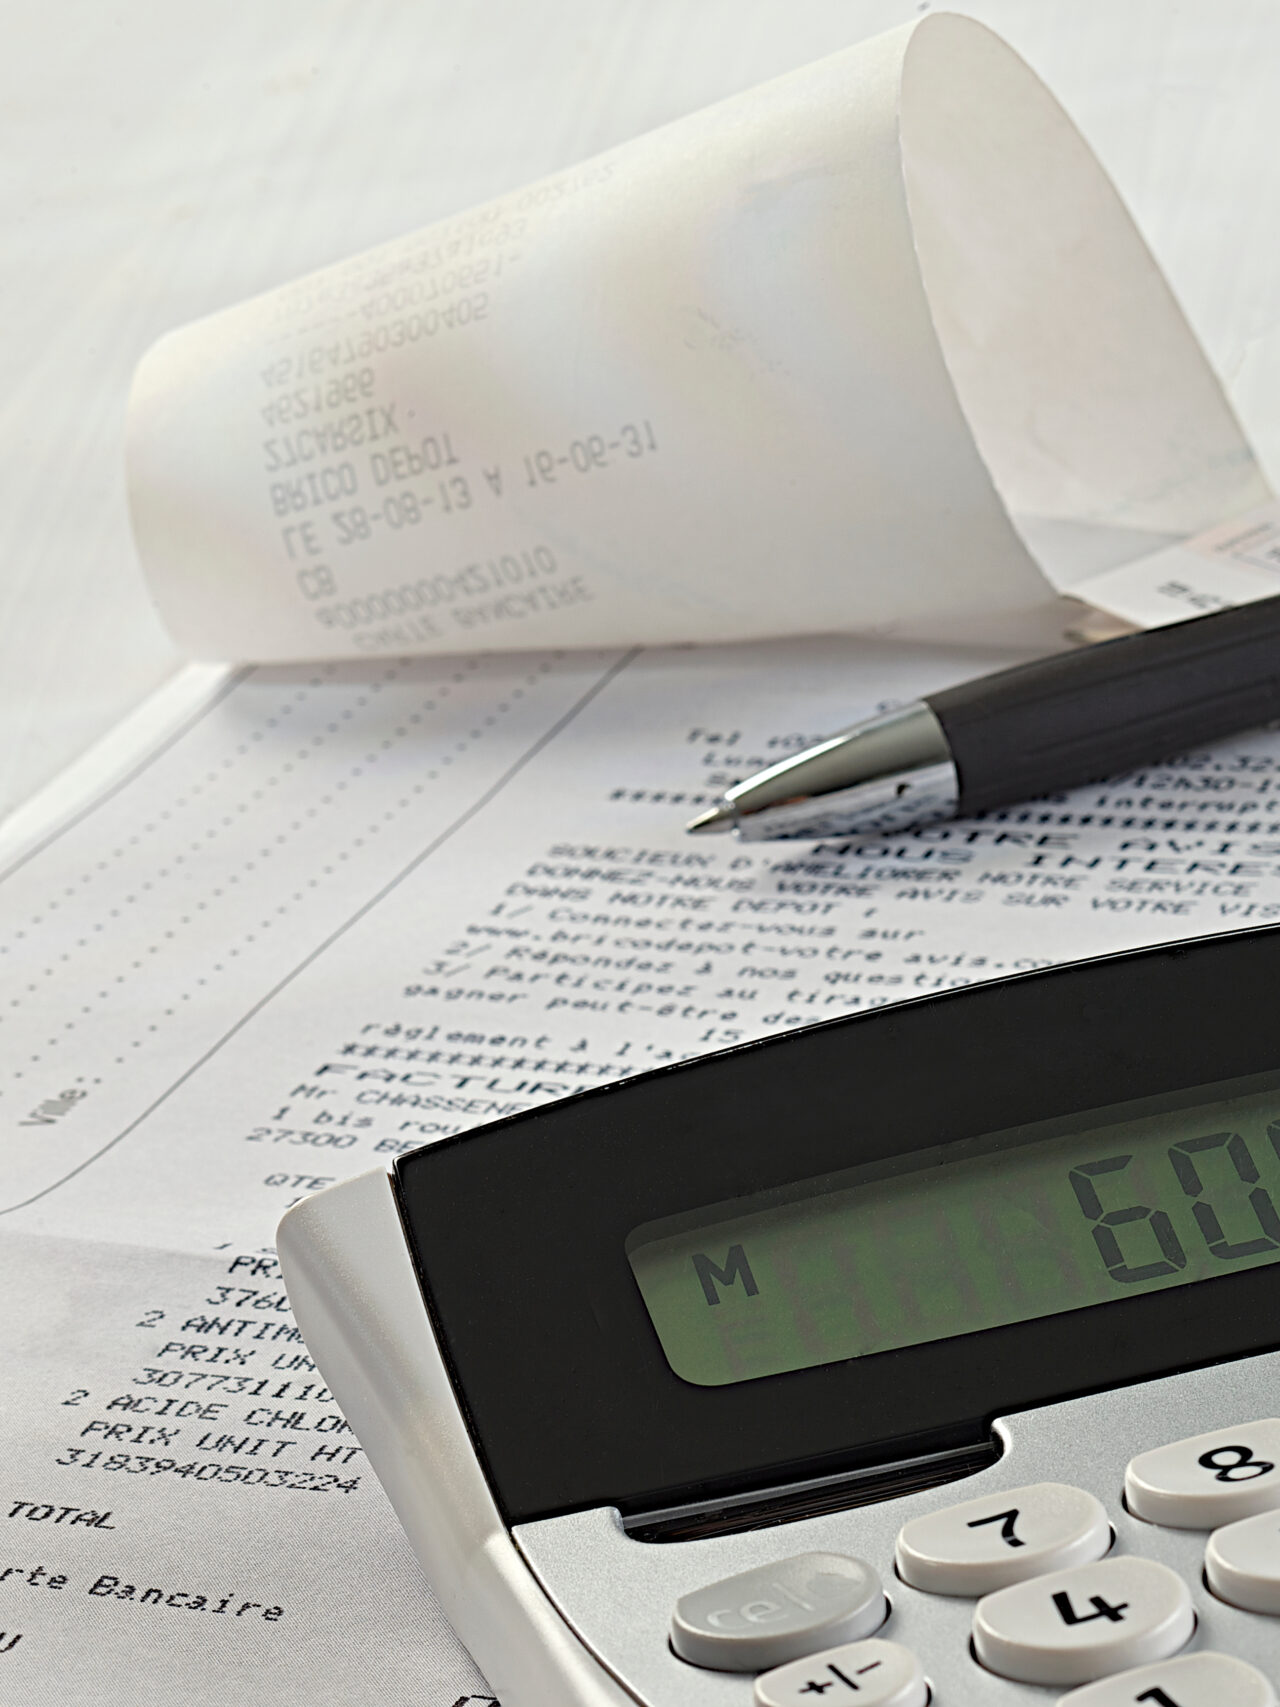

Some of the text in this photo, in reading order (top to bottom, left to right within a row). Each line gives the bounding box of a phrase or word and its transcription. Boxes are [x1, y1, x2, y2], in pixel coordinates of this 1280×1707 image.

[810, 842, 976, 865] NOUS
[504, 881, 592, 902] DANS
[608, 890, 714, 913] NOTRE
[731, 896, 840, 917] DEPOT
[526, 861, 757, 893] DONNEZ-NOUS
[775, 879, 880, 898] VOTRE
[896, 886, 985, 905] AVIS
[1002, 891, 1071, 910] SUR
[1091, 896, 1198, 917] VOTRE
[979, 870, 1087, 891] NOTRE
[1105, 875, 1259, 900] SERVICE
[547, 906, 837, 938] Connectez-vous
[857, 928, 926, 942] sur
[902, 951, 1066, 969] avis.co
[484, 963, 699, 999] Participez
[717, 986, 758, 1002] au
[786, 988, 895, 1008] tirag
[737, 964, 798, 983] nos
[823, 971, 985, 989] questio
[402, 982, 528, 1004] gagner
[698, 1027, 745, 1044] 15
[289, 1084, 338, 1099] Mr
[313, 1108, 375, 1129] bis
[400, 1119, 482, 1135] rou
[246, 1126, 359, 1150] 27300
[227, 1255, 283, 1280] PR
[692, 1244, 760, 1306] M
[135, 1309, 166, 1329] 2
[156, 1342, 257, 1366] PRIX
[61, 1389, 89, 1408] 2
[106, 1394, 229, 1422] ACIDE
[79, 1419, 363, 1465] PRIX UNIT HT
[55, 1448, 361, 1495] 3183940503224
[966, 1508, 1026, 1548] 7
[1198, 1445, 1275, 1483] 8
[6, 1500, 117, 1530] TOTAL
[88, 1575, 285, 1622] Bancaire
[1051, 1590, 1129, 1625] 4
